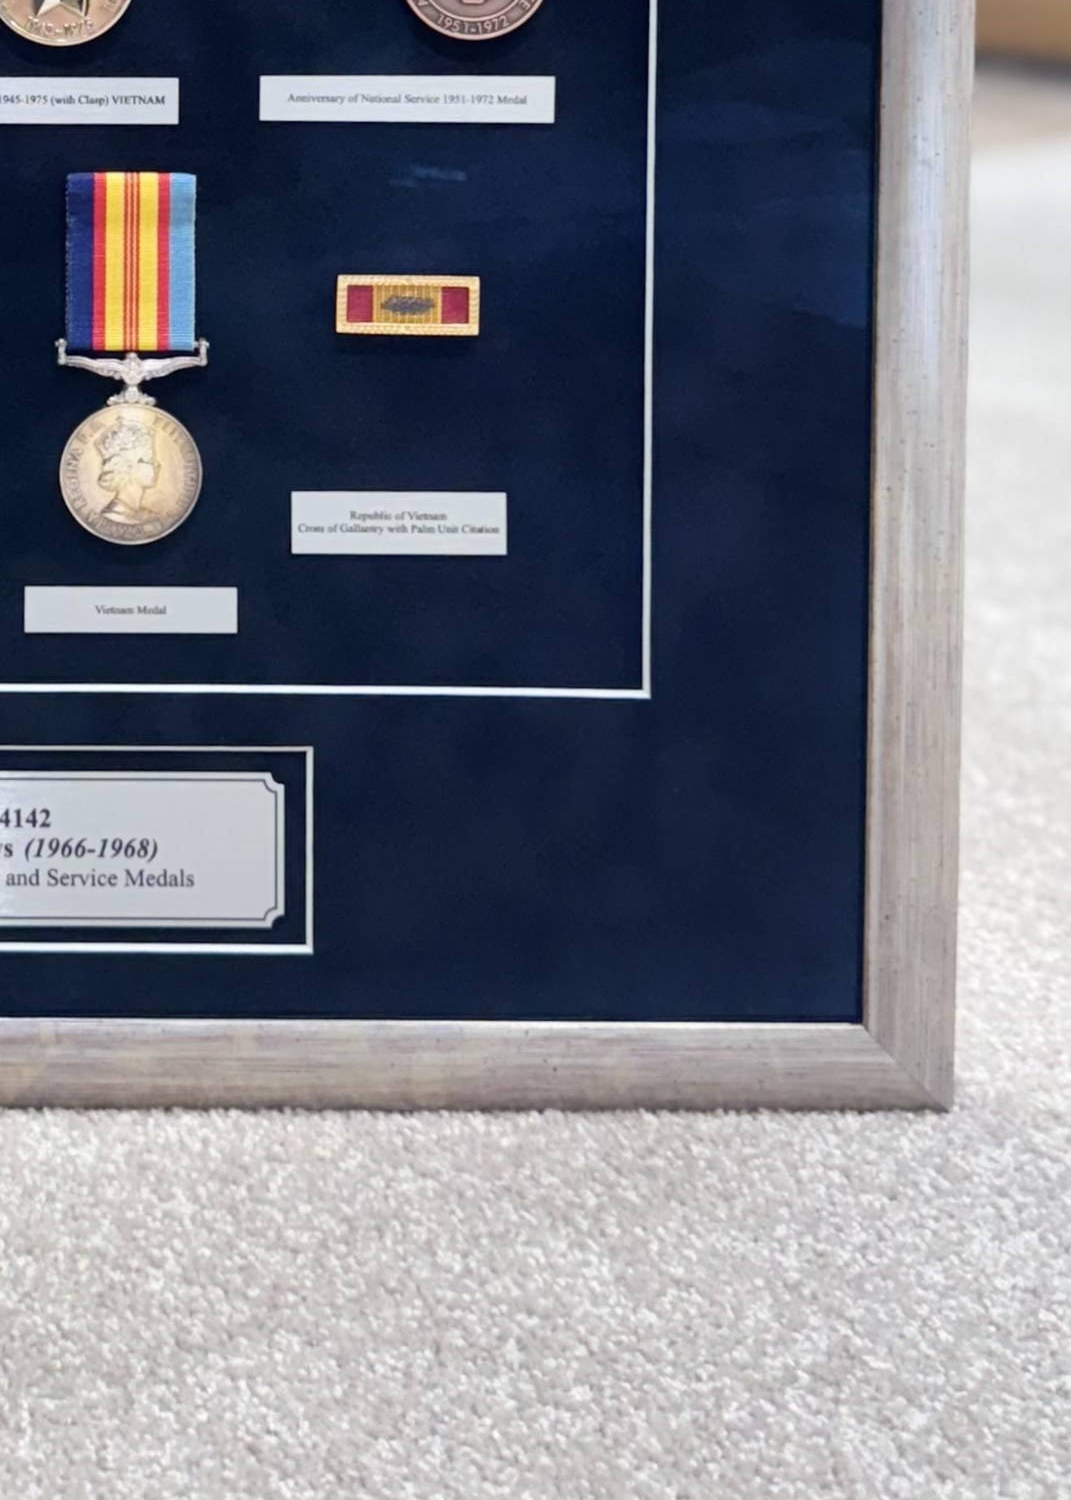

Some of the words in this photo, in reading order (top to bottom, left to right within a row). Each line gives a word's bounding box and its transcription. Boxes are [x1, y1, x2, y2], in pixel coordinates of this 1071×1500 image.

[50, 95, 75, 106] (with
[78, 95, 109, 107] Clasp)
[112, 95, 165, 105] VIETNAM
[287, 94, 345, 105] Anniversary
[348, 94, 358, 103] of
[360, 94, 401, 104] National
[405, 94, 440, 104] Service
[443, 94, 494, 105] 1951-1972
[497, 95, 527, 105] Medal
[350, 511, 392, 522] Republic
[394, 511, 406, 521] of
[408, 511, 447, 521] Vietnam
[298, 523, 325, 534] Cross
[327, 523, 337, 534] of
[339, 523, 384, 535] Gallantry
[387, 523, 408, 534] with
[411, 523, 435, 534] Palm
[438, 523, 459, 534] Unit
[461, 523, 499, 534] Citation
[95, 605, 133, 615] Vietnam
[137, 605, 167, 615] Medal
[23, 837, 158, 862] (1966-1968)
[6, 867, 40, 887] and
[47, 867, 117, 887] Service
[124, 867, 195, 887] Medals
